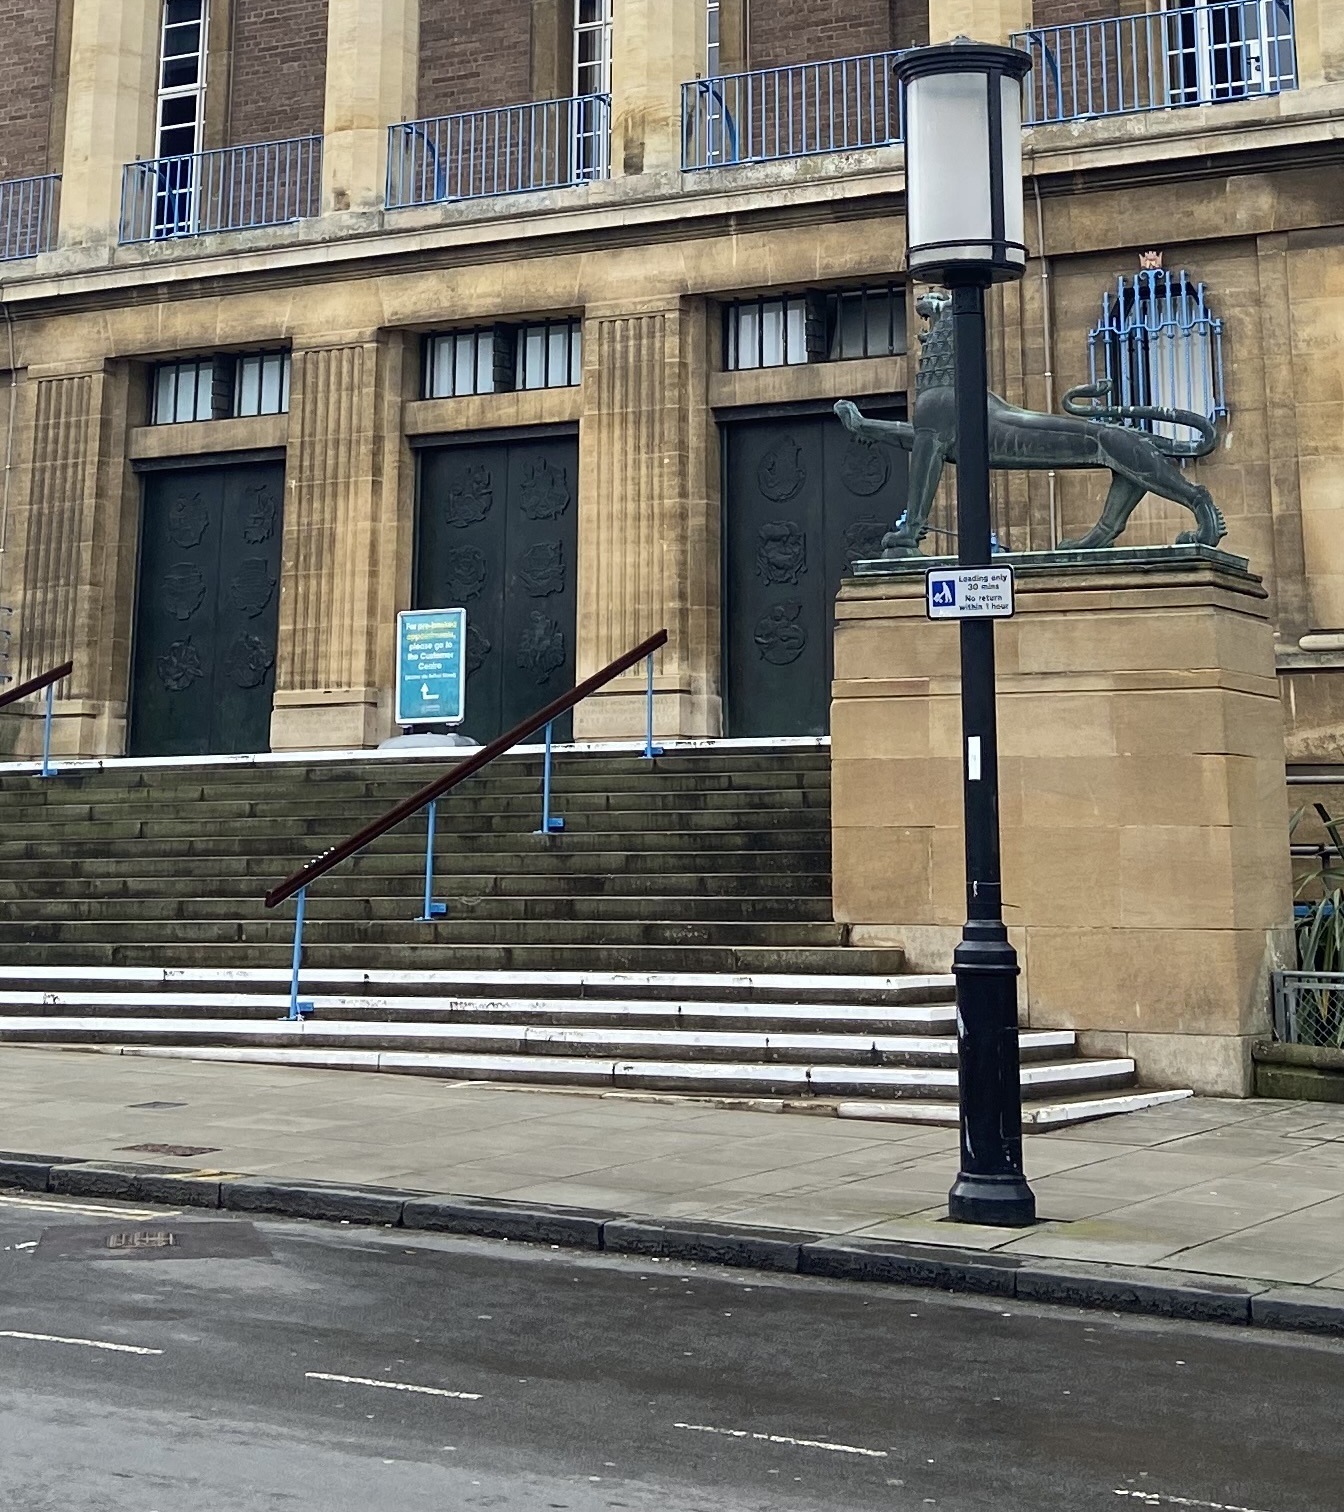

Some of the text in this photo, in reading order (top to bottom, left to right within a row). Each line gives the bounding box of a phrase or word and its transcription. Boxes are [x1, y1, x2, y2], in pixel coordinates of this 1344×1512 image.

[958, 573, 1008, 583] Loading only
[967, 583, 979, 591] 30
[978, 594, 1003, 602] return
[991, 602, 1009, 610] hour
[409, 641, 453, 652] please go to
[407, 653, 419, 661] the
[418, 662, 443, 670] Centre
